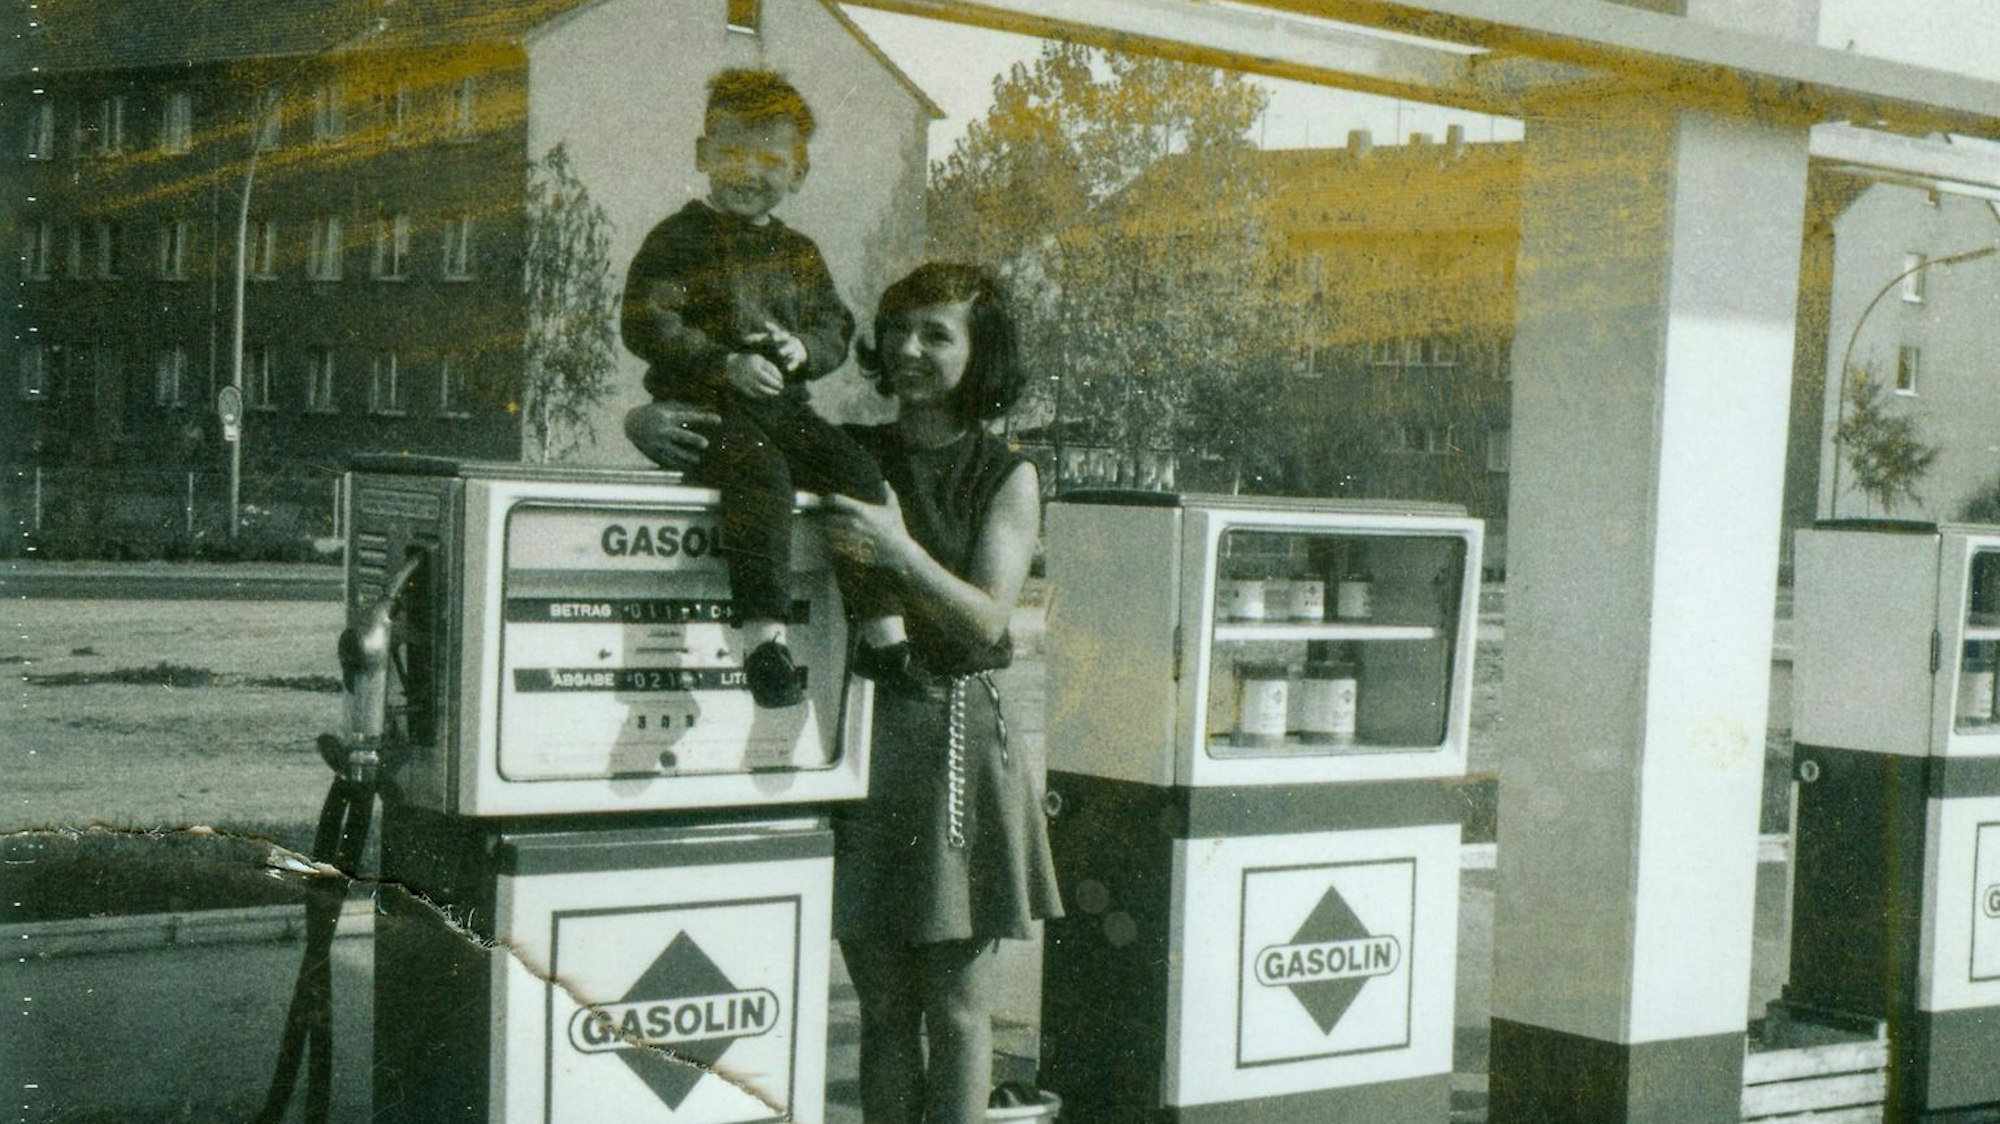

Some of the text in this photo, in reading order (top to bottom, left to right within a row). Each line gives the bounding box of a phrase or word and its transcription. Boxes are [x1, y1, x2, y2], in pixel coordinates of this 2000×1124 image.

[550, 603, 612, 618] BETRAG
[552, 672, 615, 687] ABGABE
[1264, 942, 1391, 980] GASOLIN
[582, 997, 766, 1046] GASOLIN
